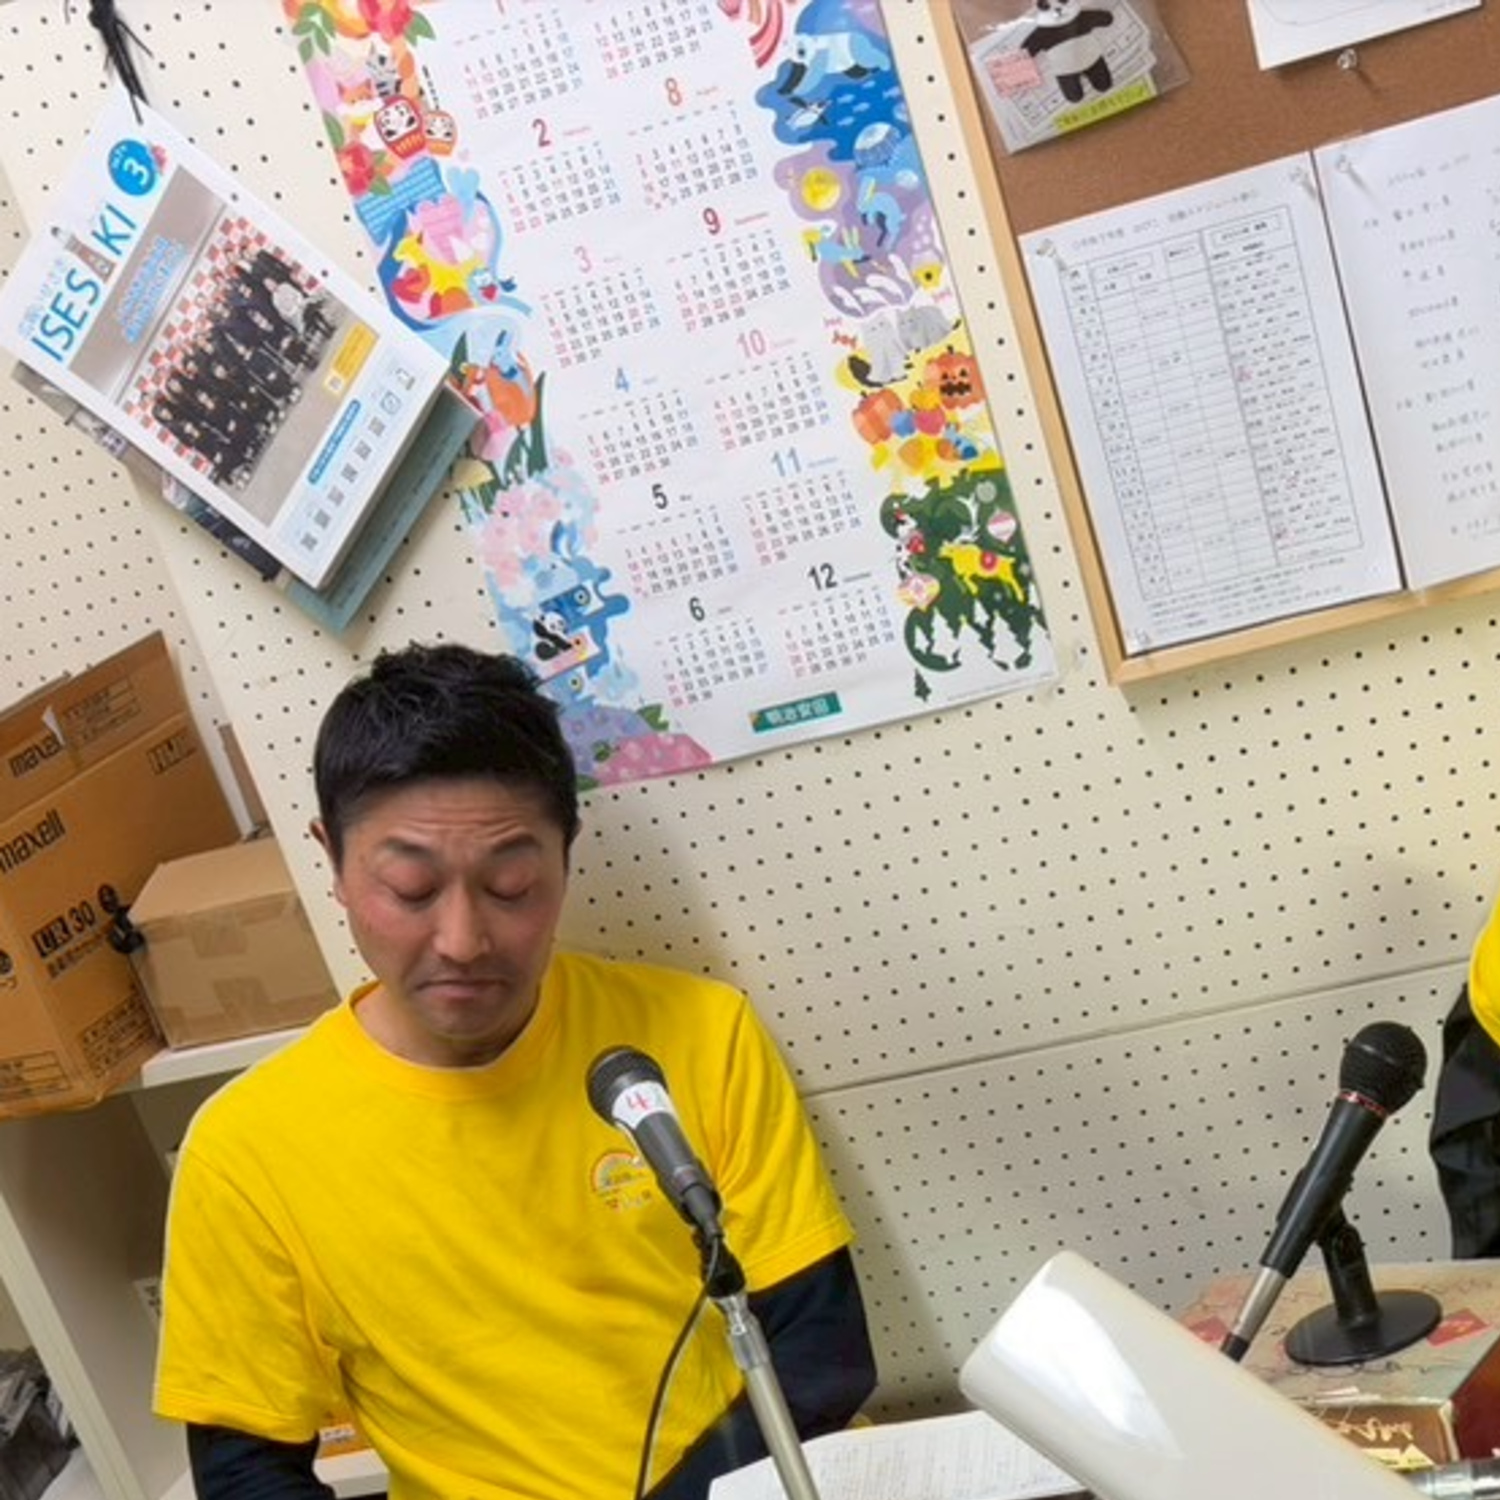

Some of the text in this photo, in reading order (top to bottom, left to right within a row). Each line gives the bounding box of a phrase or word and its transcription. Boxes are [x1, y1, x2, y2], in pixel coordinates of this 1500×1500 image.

[664, 77, 682, 106] 8
[532, 118, 550, 147] 2
[122, 157, 148, 186] 3
[703, 207, 720, 235] 9
[574, 245, 592, 273] 3
[737, 329, 765, 357] 10
[615, 367, 628, 391] 4
[771, 447, 801, 476] 11
[652, 483, 667, 509] 5
[808, 563, 837, 590] 12
[689, 597, 704, 621] 6
[8, 730, 63, 778] maxel
[69, 900, 96, 933] 30
[627, 1090, 651, 1112] 4
